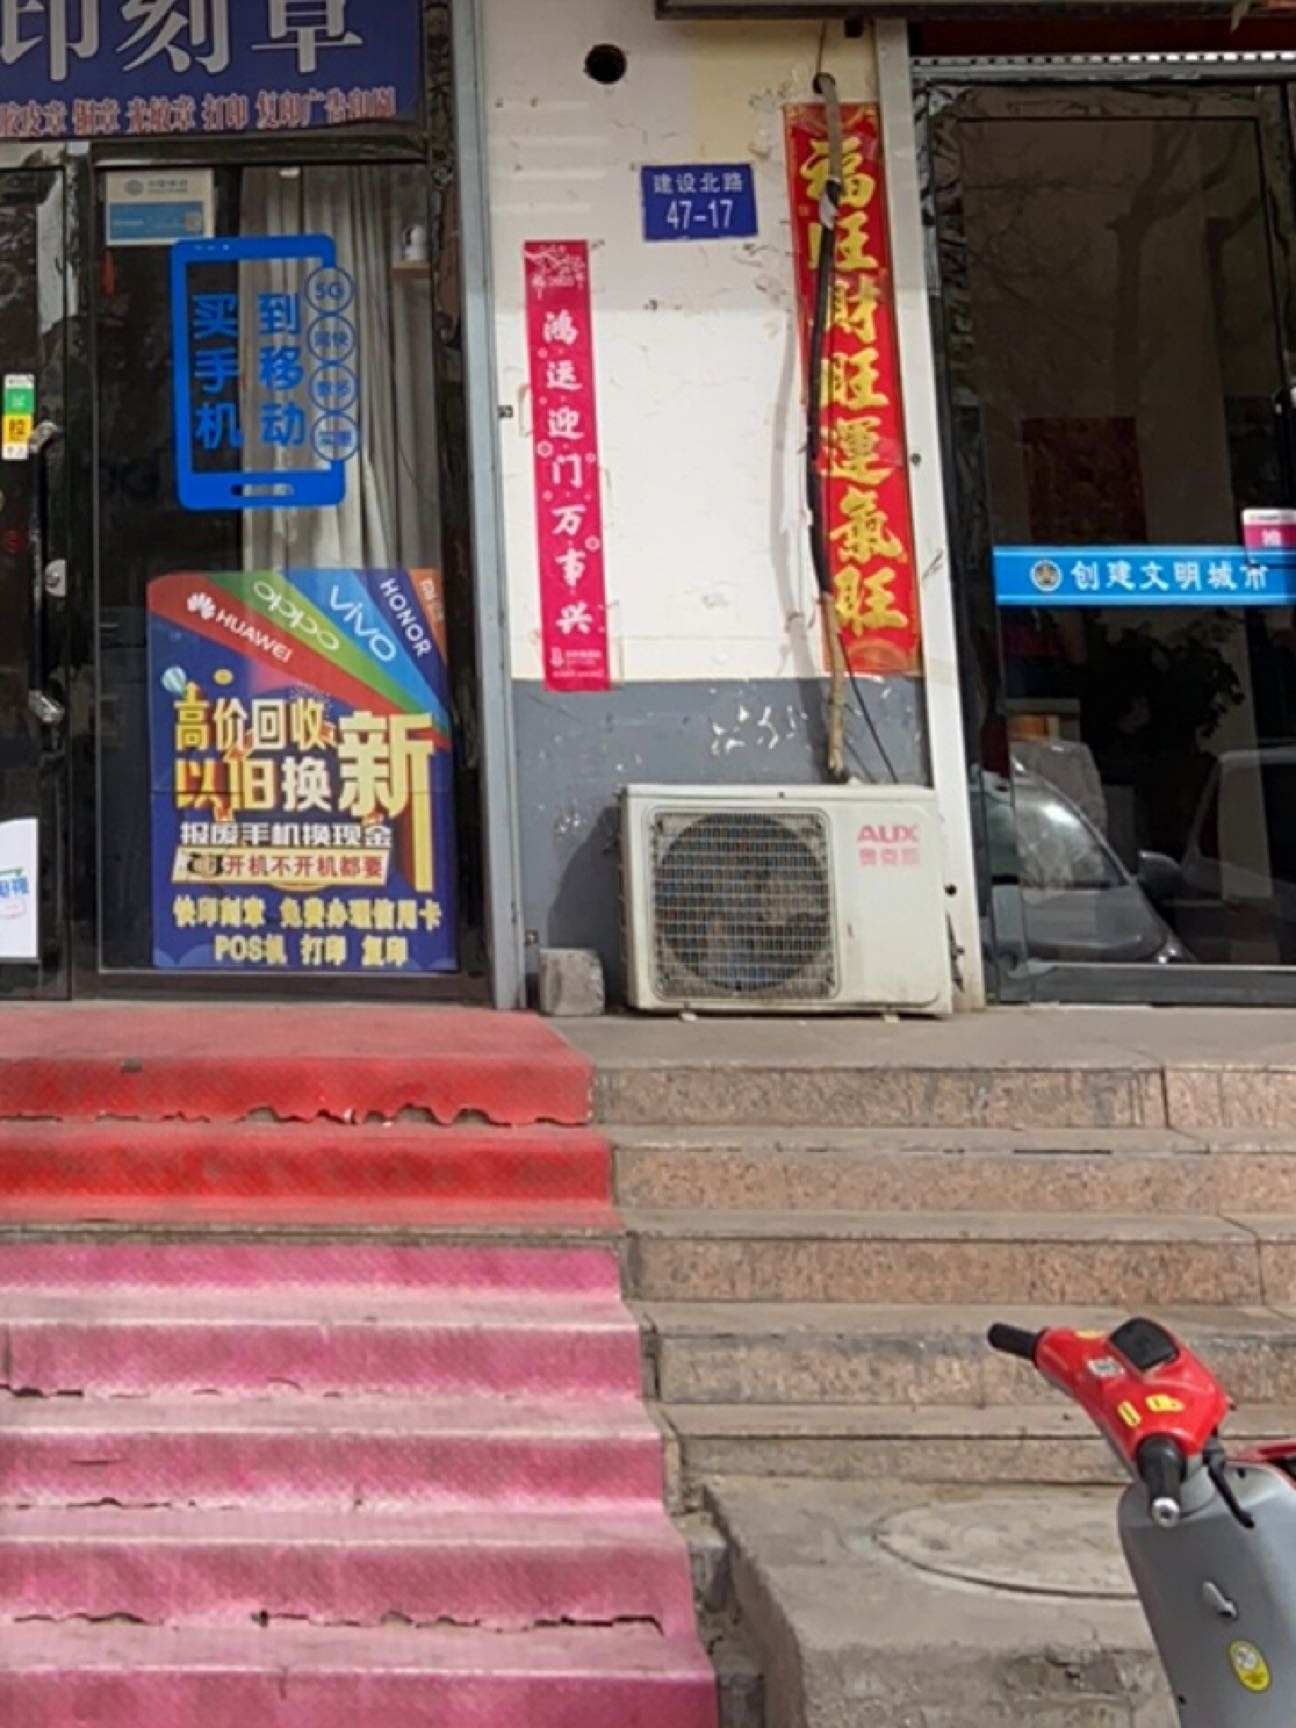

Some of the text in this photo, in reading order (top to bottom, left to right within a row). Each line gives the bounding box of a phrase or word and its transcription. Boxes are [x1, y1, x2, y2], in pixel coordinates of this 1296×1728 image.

[653, 171, 744, 194] 建设北路
[665, 199, 734, 231] 47-17
[191, 293, 245, 450] 买手机
[257, 292, 306, 447] 到移动
[543, 308, 604, 636] 鸿运迎门万事兴
[1070, 560, 1268, 592] 创建文明城市
[215, 608, 294, 663] HUAWEI
[380, 577, 432, 657] HONOR
[174, 682, 327, 751] 高价回收
[857, 824, 920, 844] AUX
[224, 855, 383, 878] 开机不开机都要
[214, 934, 408, 967] POS机 打印 复印
